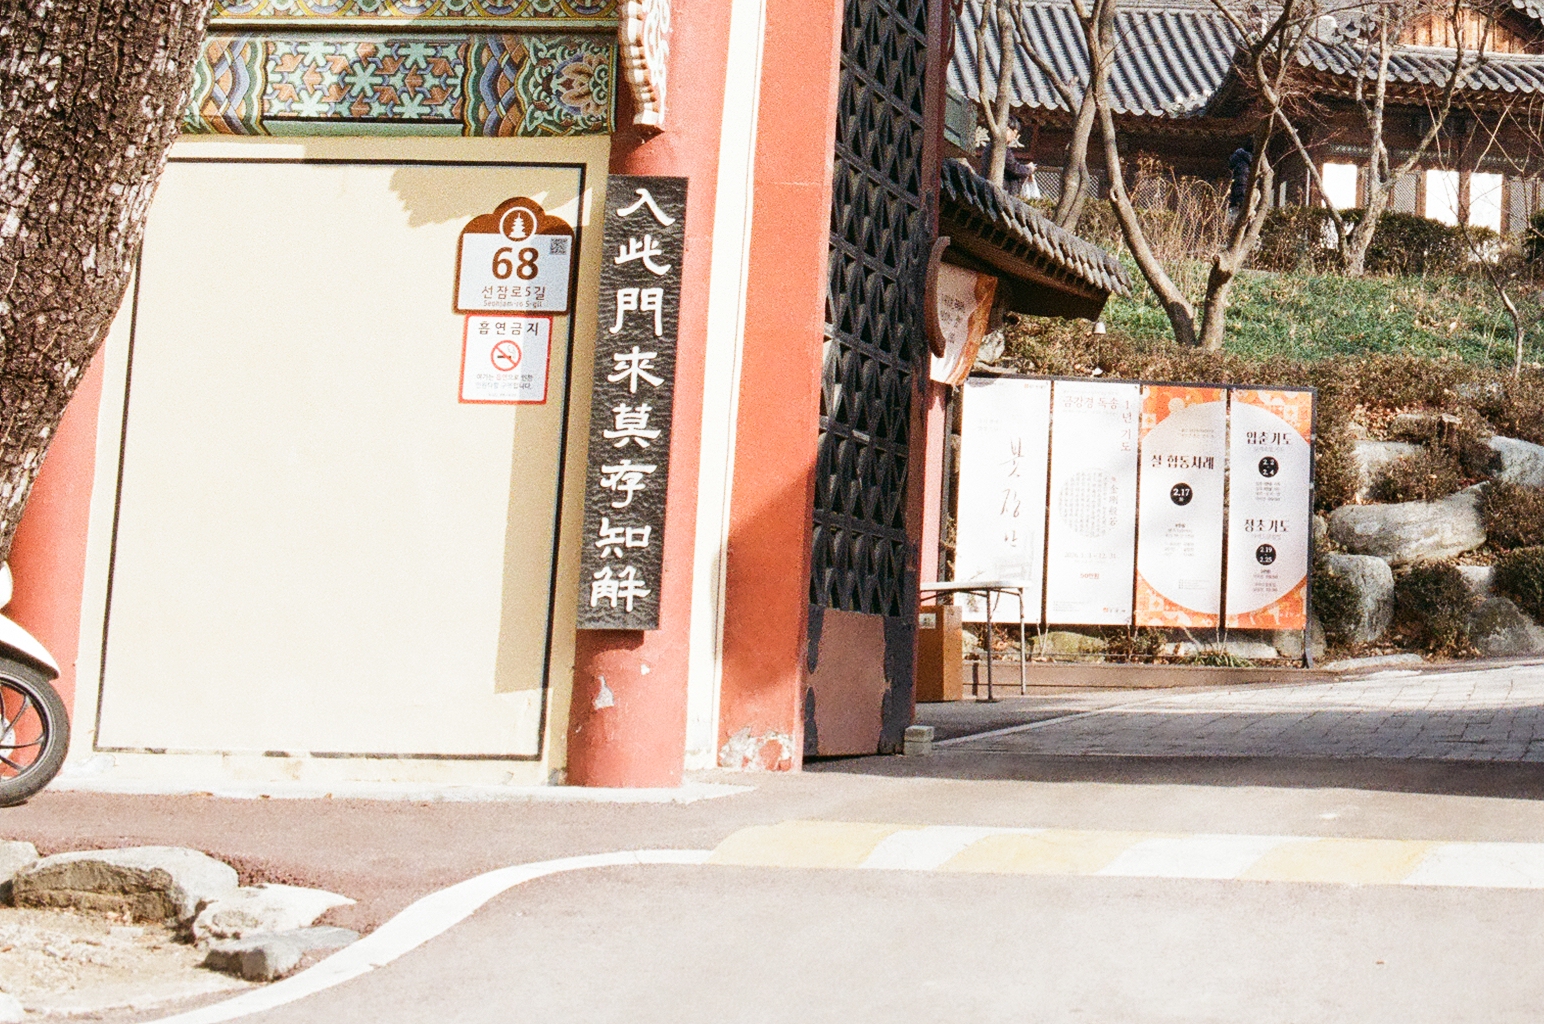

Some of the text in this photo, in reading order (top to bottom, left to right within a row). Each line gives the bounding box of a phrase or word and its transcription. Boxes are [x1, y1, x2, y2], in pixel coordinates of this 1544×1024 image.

[492, 246, 539, 280] 68
[481, 285, 546, 300] 선잠로5길
[478, 321, 540, 336] 흡연금지
[590, 187, 676, 613] 入此門來莫存知解
[1246, 431, 1293, 445] 입춘기도
[1167, 456, 1215, 470] 합동차례
[1172, 488, 1190, 497] 2.17
[1244, 519, 1289, 533] 정초기도
